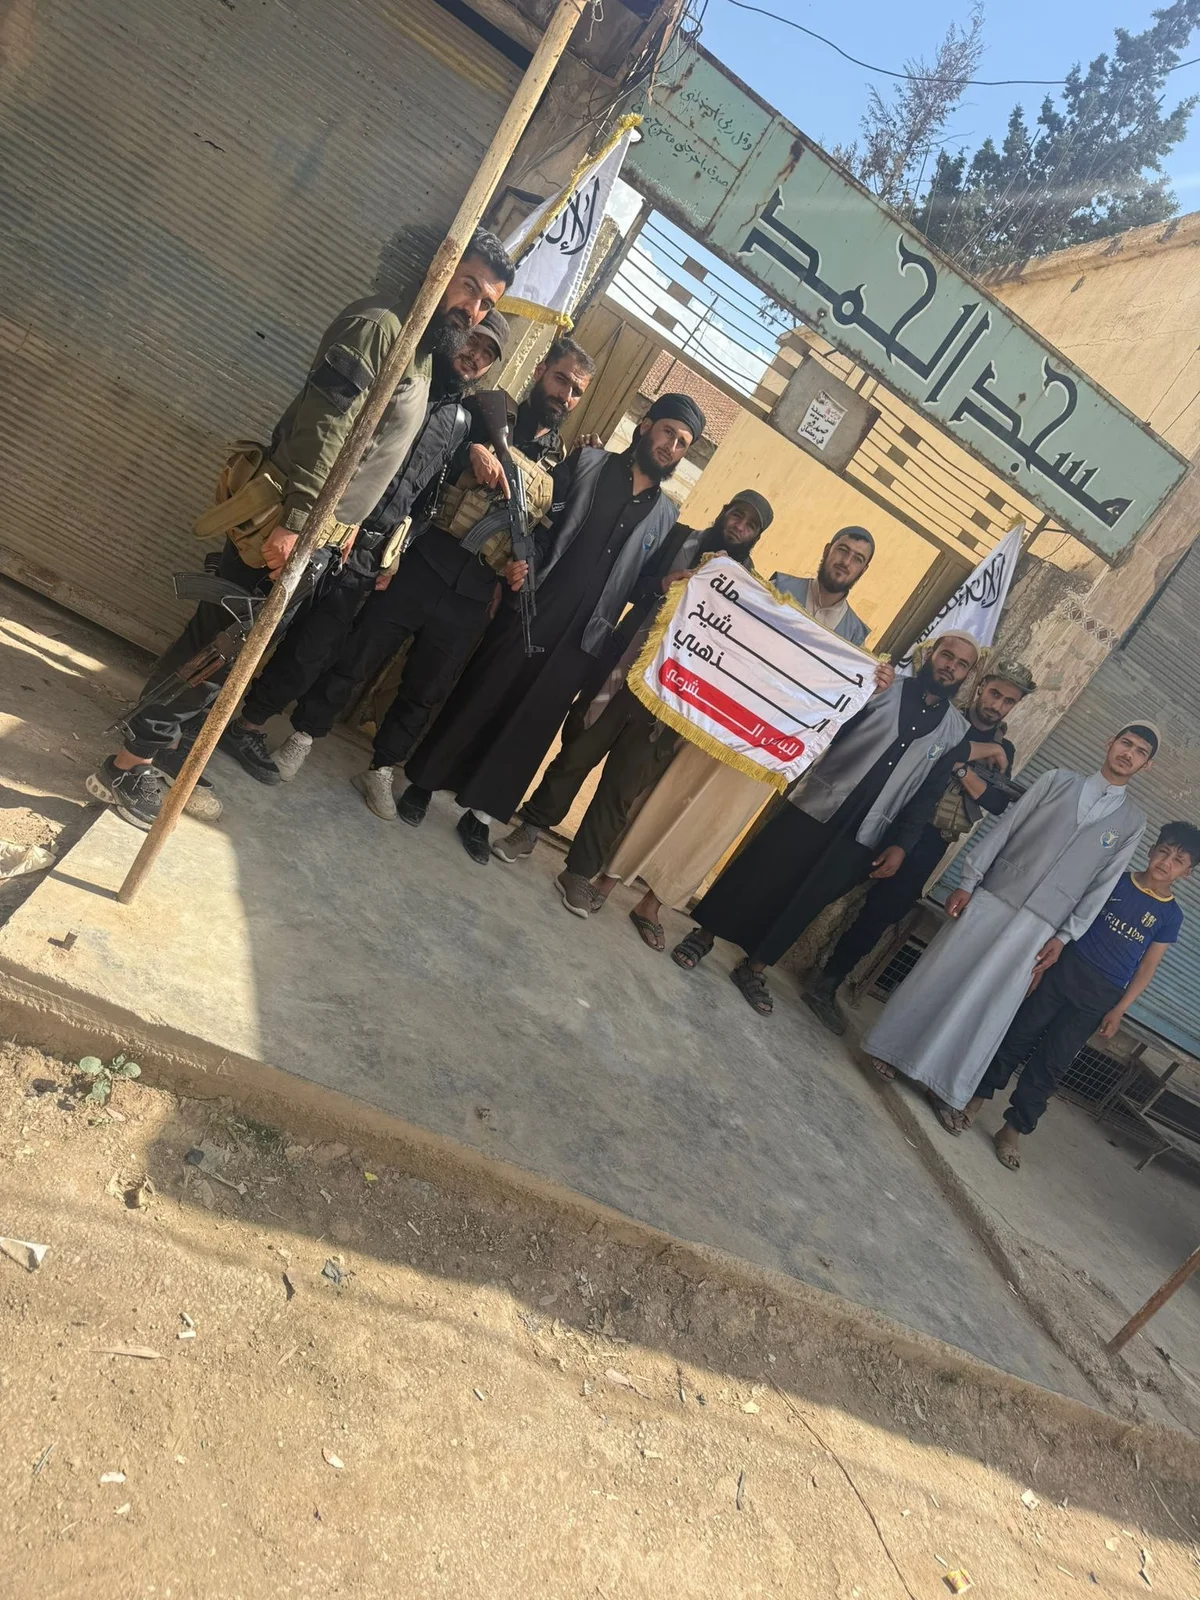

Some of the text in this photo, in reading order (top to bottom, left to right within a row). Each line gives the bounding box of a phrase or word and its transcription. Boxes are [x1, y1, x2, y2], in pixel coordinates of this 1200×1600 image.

[737, 185, 1135, 531] مسجد الحمد
[673, 628, 831, 733] الذهبي
[688, 600, 852, 713] الشيخ
[709, 573, 864, 689] حملة
[666, 667, 800, 756] للباس الشرعي
